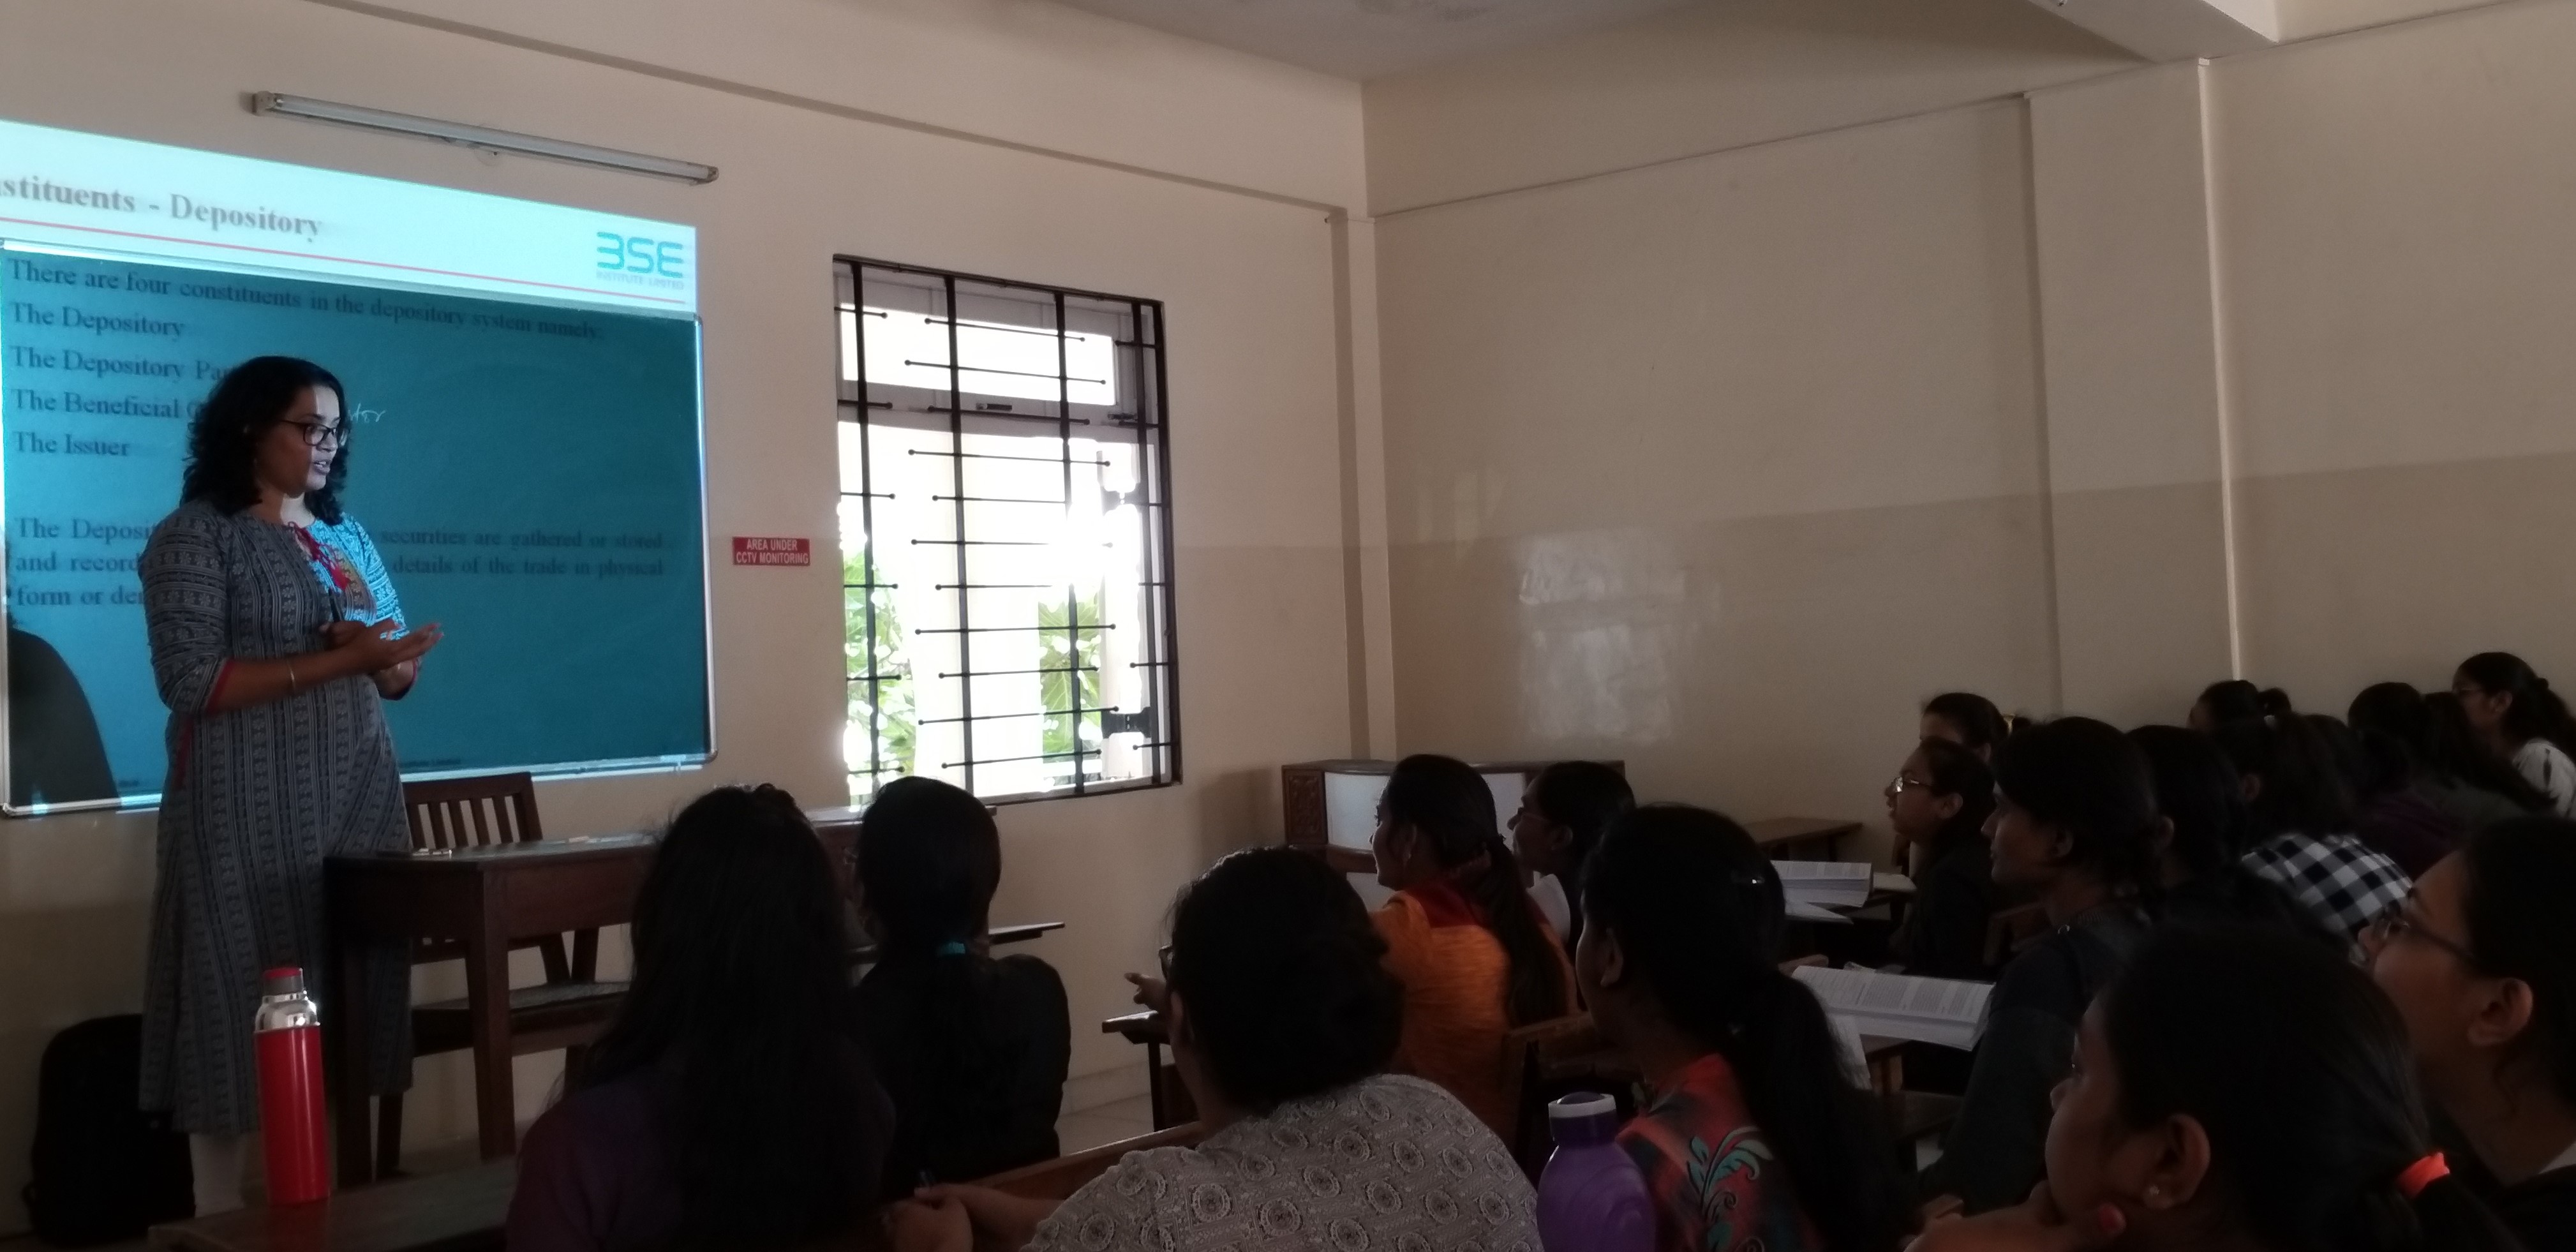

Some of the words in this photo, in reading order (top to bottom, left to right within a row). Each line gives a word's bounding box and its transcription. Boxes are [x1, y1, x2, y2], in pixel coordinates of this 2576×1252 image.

[0, 175, 135, 212] stituents
[170, 193, 322, 242] Depository
[9, 258, 77, 285] There
[85, 272, 120, 289] are
[126, 272, 171, 294] four
[179, 283, 301, 308] constituents
[310, 294, 329, 311] in
[336, 296, 364, 314] the
[370, 297, 465, 327] depository
[472, 313, 531, 336] system
[9, 302, 54, 325] The
[63, 306, 185, 338] Depository
[10, 345, 56, 368] The
[64, 350, 186, 384] Depository
[11, 389, 56, 412] The
[64, 391, 179, 419] Beneficial
[13, 431, 57, 454] The
[65, 433, 129, 456] Issuer
[15, 518, 59, 539] The
[72, 519, 149, 546] Deposi
[382, 529, 466, 546] securities
[474, 533, 501, 546] are
[510, 530, 582, 551] gathered
[590, 535, 607, 548] or
[614, 531, 663, 549] stored
[736, 551, 757, 563] CCTV
[759, 552, 809, 564] MONITORING
[747, 539, 768, 551] AREA
[770, 539, 798, 551] UNDER
[15, 551, 57, 570] and
[392, 555, 453, 574] details
[461, 554, 480, 574] of
[489, 555, 514, 574] the
[523, 556, 567, 575] trade
[576, 556, 590, 574] in
[599, 555, 663, 579] physical
[17, 585, 71, 604] form
[80, 592, 104, 605] or
